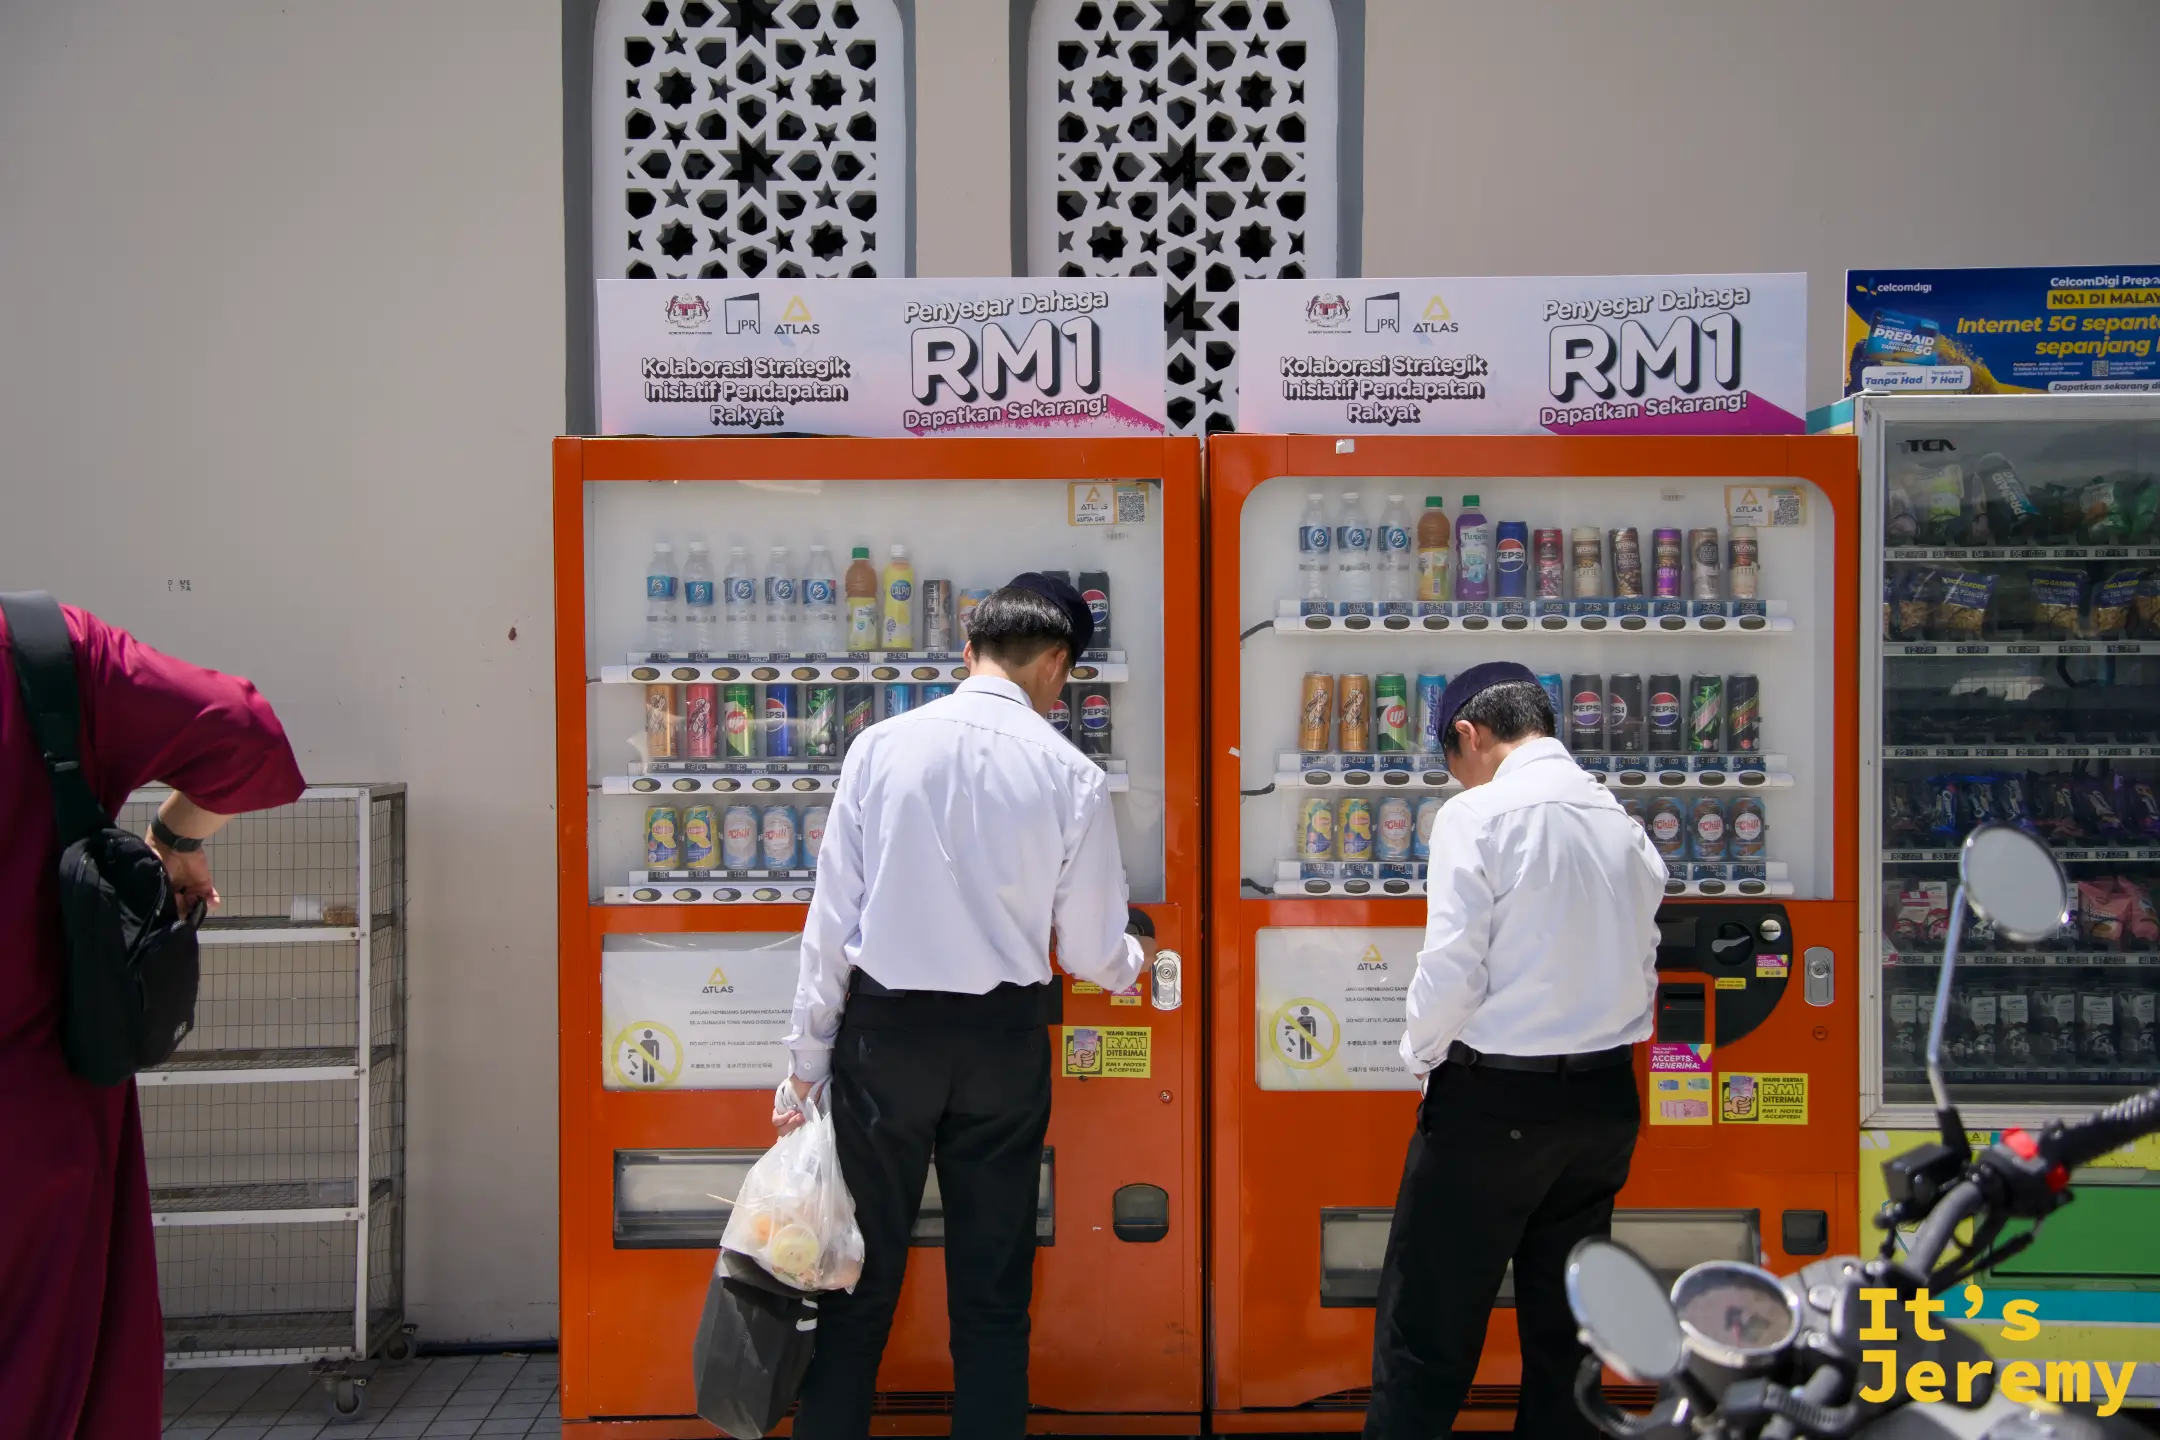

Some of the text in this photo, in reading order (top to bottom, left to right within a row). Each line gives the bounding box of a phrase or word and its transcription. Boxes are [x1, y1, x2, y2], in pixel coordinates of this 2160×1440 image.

[2050, 275, 2119, 287] CelcomDigi
[1877, 283, 1932, 293] celcomdigi
[1543, 287, 1750, 322] Penyegar Dahaga
[2052, 294, 2085, 305] NO.1
[2089, 294, 2105, 304] DI
[904, 290, 1107, 324] Penyegar Dahaga
[774, 324, 820, 335] ATLAS
[1412, 322, 1459, 333] ATLAS
[1957, 314, 2160, 334] Internet 5G sepant
[1873, 328, 1935, 346] PREPAID
[1914, 346, 1932, 356] 5G
[2035, 336, 2151, 358] sepanjang
[911, 315, 1100, 406] RM1
[1549, 312, 1740, 403] RM1
[642, 356, 850, 380] Kolaborasi Strategik
[1280, 354, 1488, 378] Kolaborasi Strategik
[1865, 376, 1923, 386] Tanpa Had
[1931, 374, 1963, 384] 7 Hari
[645, 381, 849, 405] Inisiatif Pendapatan
[1283, 379, 1486, 403] Inisiatif Pendapatan
[2054, 382, 2101, 392] Dapatkan
[2104, 382, 2149, 392] sekarang
[904, 394, 1108, 430] Dapatkan Sekarang!
[1540, 390, 1747, 426] Dapatkan Sekarang!
[710, 404, 784, 429] Rakyat
[1347, 403, 1421, 427] Rakyat
[1497, 551, 1524, 559] PEPSI
[812, 583, 825, 598] K2
[1088, 602, 1108, 610] EPSI
[1047, 712, 1068, 720] EPSI
[1082, 708, 1108, 716] PEPSI
[702, 986, 734, 994] ATLAS
[1106, 1037, 1148, 1050] RM1
[1652, 1054, 1694, 1062] ACCEPTS:
[1652, 1062, 1700, 1070] MENERIMA:
[1762, 1084, 1804, 1096] RM1
[1762, 1096, 1804, 1104] DITERIMA!
